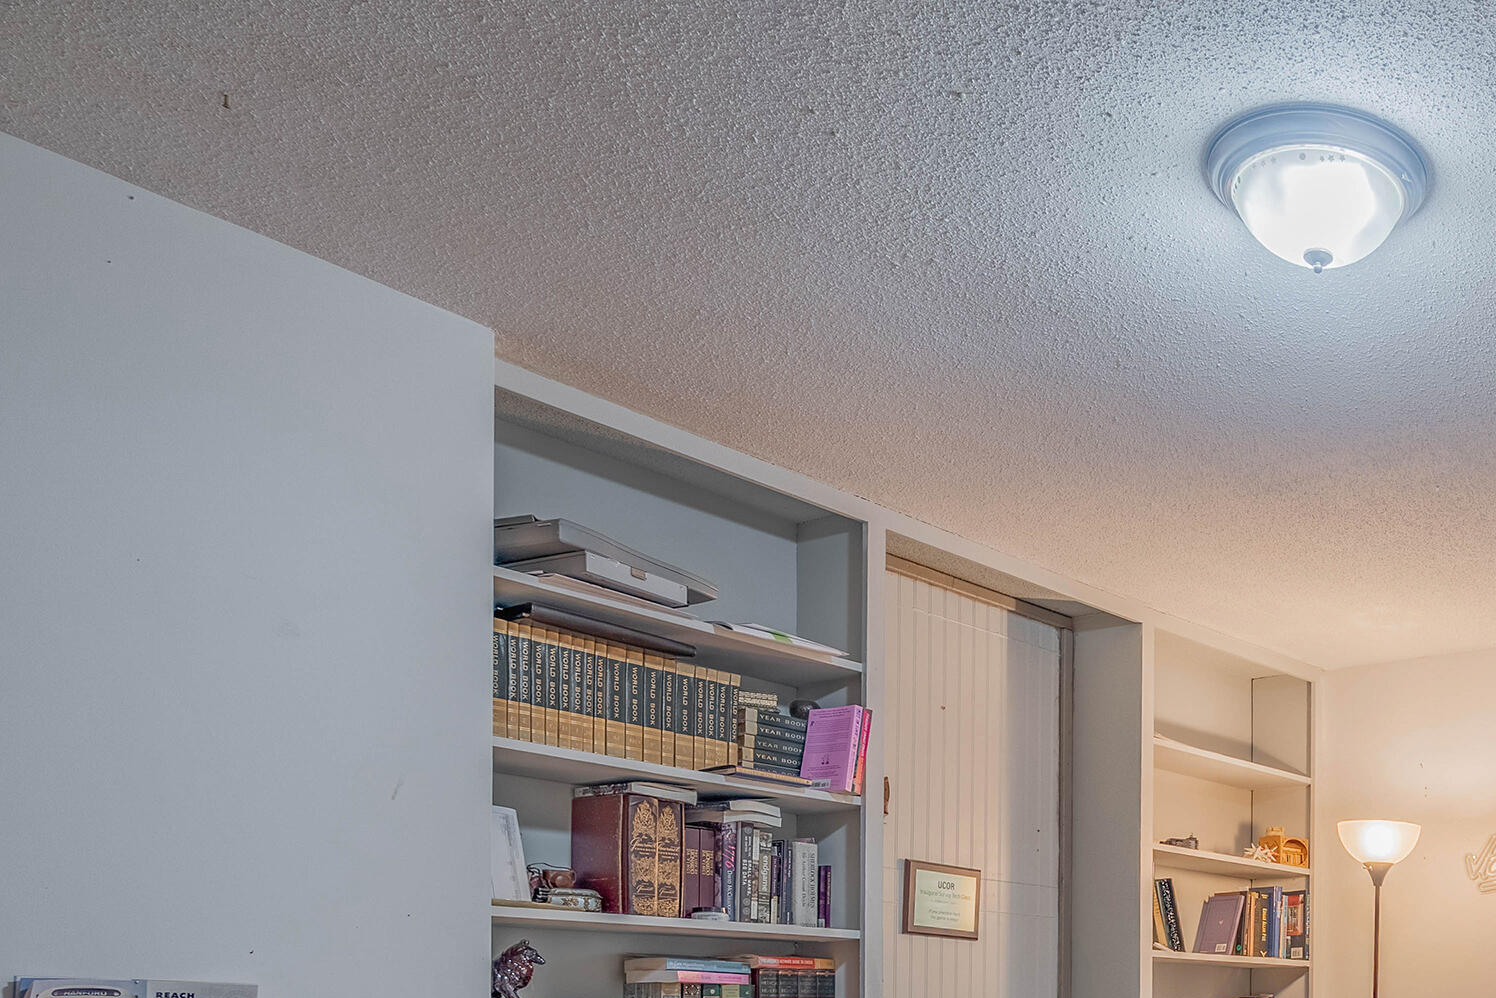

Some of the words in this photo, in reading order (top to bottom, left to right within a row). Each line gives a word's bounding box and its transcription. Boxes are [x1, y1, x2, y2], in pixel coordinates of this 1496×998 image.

[509, 639, 517, 669] WORLD
[509, 673, 517, 698] BOOK
[759, 713, 781, 723] YEAR
[784, 719, 807, 728] BOOK
[759, 726, 781, 736] YEAR
[756, 740, 779, 750] YEAR
[755, 753, 777, 761] YEAR
[722, 845, 736, 871] 1776
[761, 855, 769, 891] endgame
[937, 881, 955, 890] UCOR
